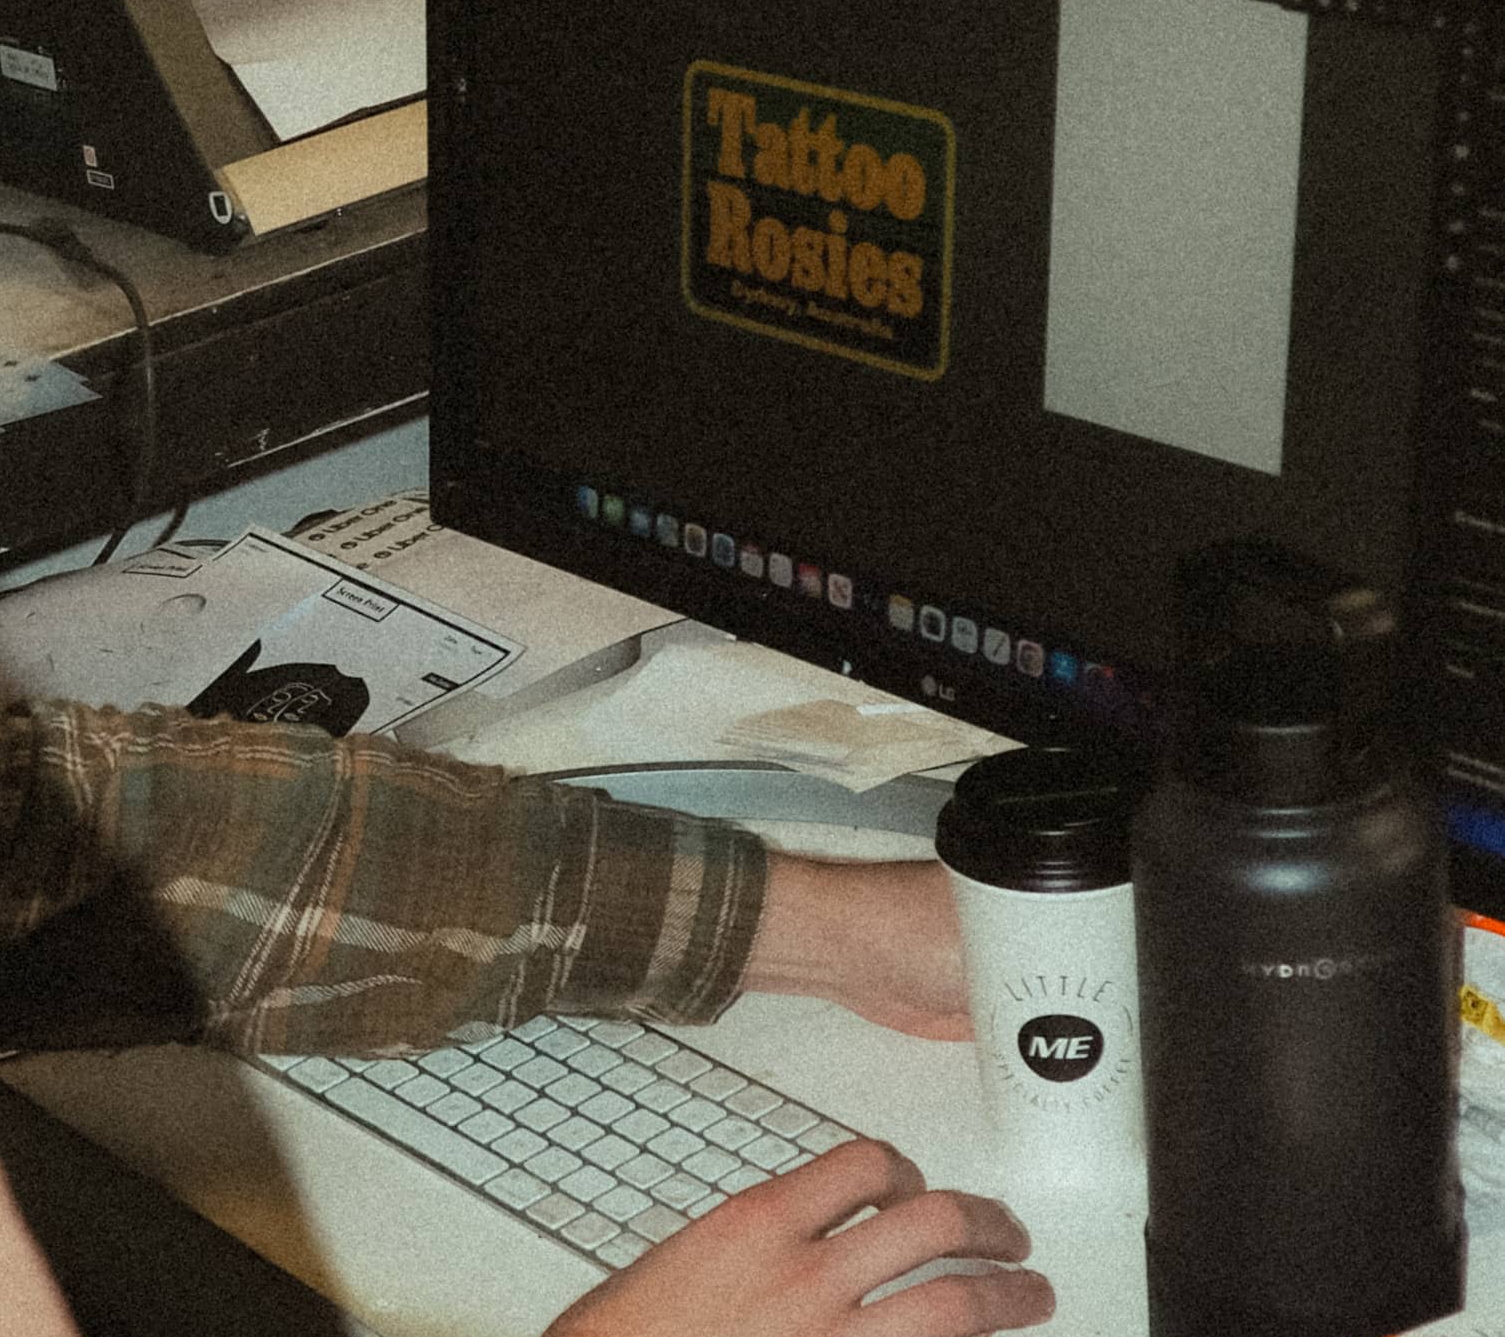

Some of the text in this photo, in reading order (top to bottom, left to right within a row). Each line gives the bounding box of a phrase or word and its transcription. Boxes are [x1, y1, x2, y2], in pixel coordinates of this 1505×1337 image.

[707, 88, 927, 221] Tattoo
[706, 180, 925, 319] Rosies
[336, 586, 364, 607] Screen
[1005, 975, 1115, 1003] LITTLE
[1028, 1036, 1094, 1060] ME
